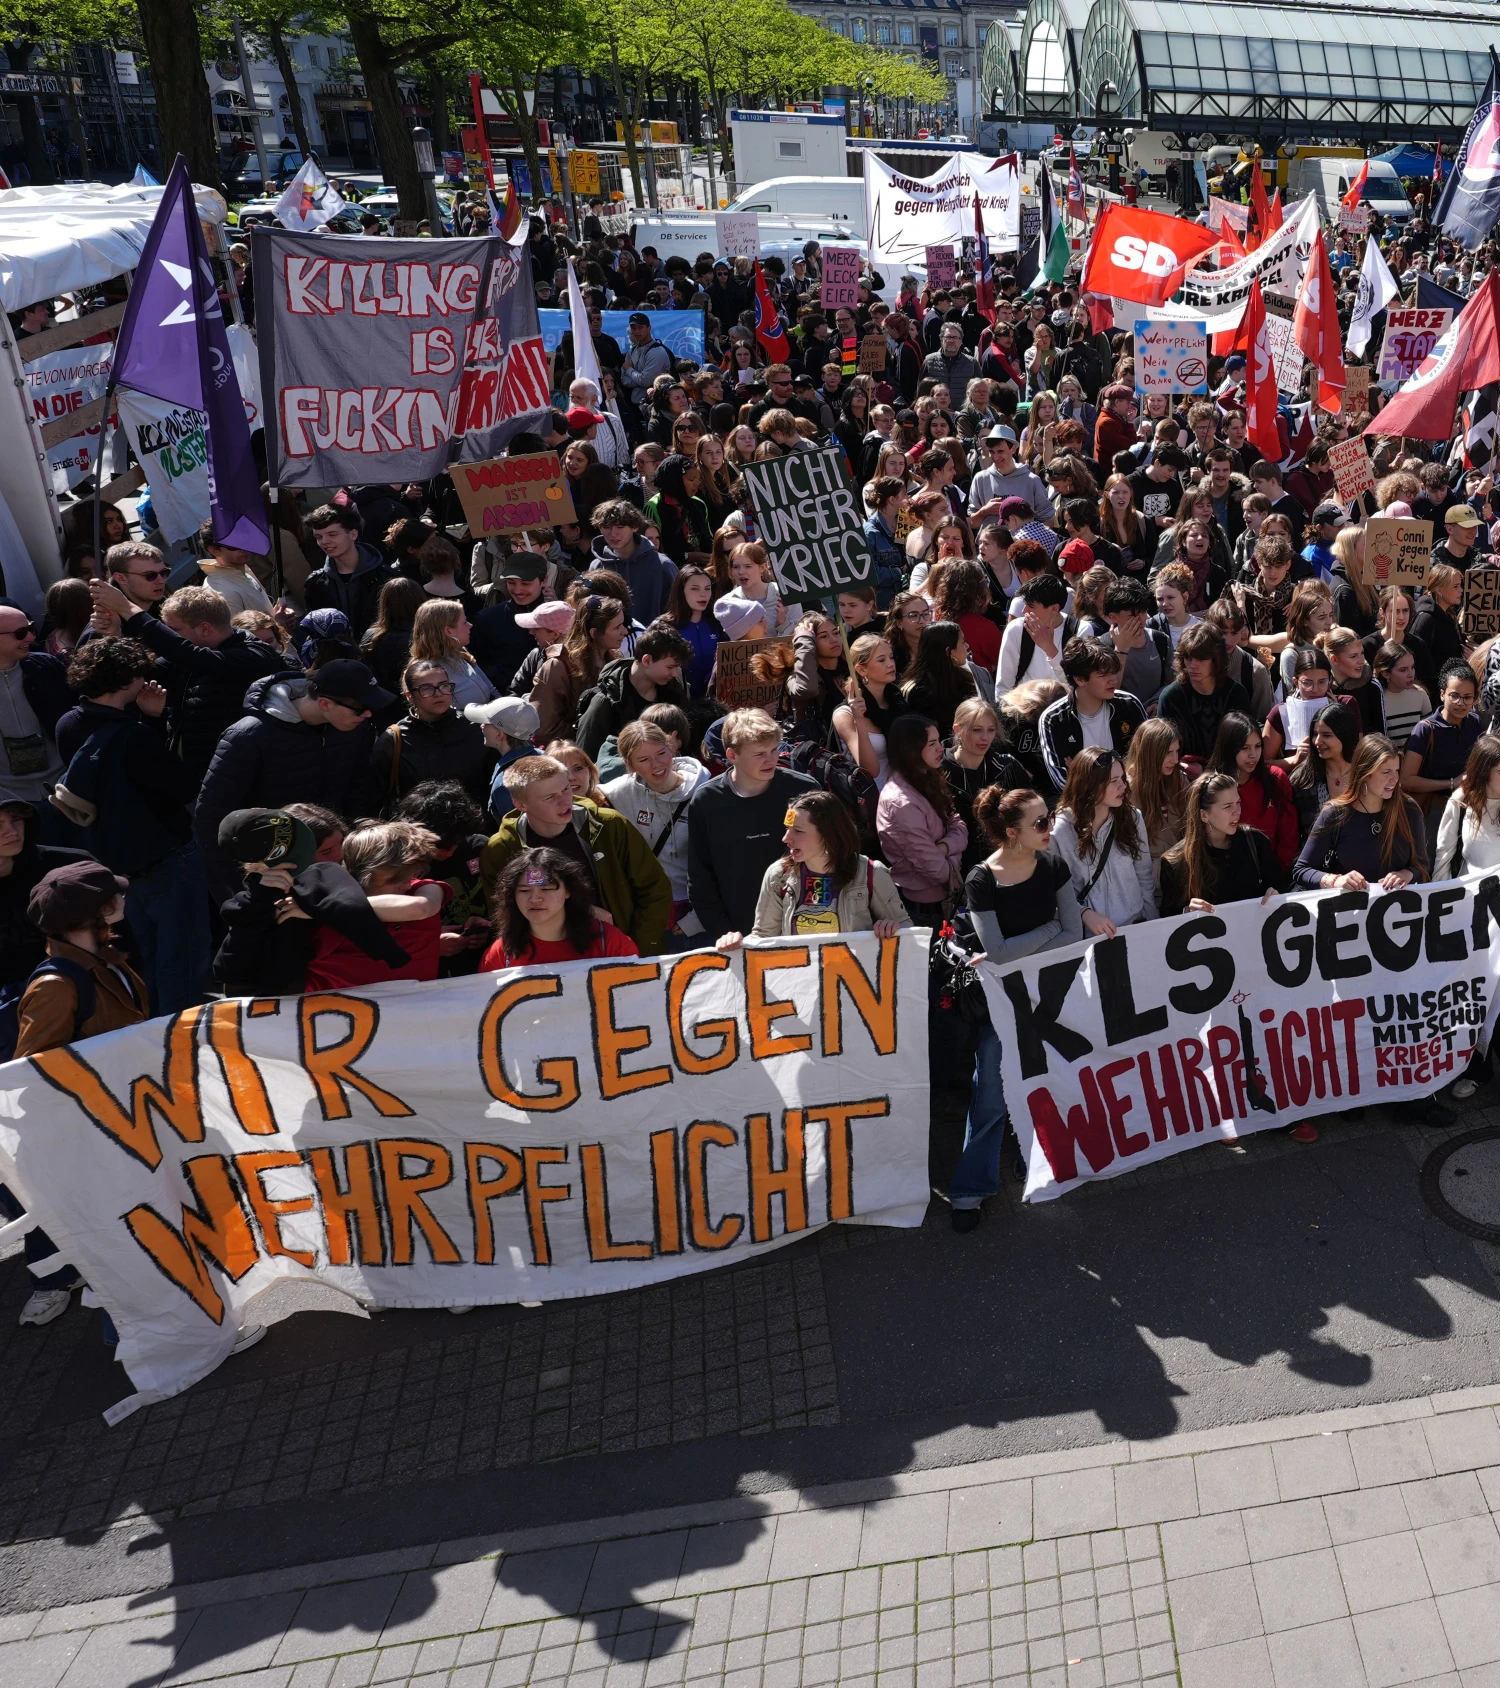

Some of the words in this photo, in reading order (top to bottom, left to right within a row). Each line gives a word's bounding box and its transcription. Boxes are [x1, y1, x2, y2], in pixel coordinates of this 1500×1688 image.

[894, 200, 934, 216] gegen
[826, 252, 857, 266] MERZ
[284, 254, 482, 317] KILLING
[826, 270, 857, 284] LECK
[1186, 278, 1239, 293] EHEN
[826, 288, 855, 303] EIER
[1165, 289, 1211, 307] URE
[1264, 294, 1295, 317] Bildung
[1389, 310, 1446, 329] HERZ
[410, 326, 457, 376] IS
[1385, 334, 1441, 358] STAT
[44, 368, 66, 384] VON
[51, 391, 83, 417] DIE
[280, 386, 463, 458] FUCKIN
[1335, 447, 1359, 463] Krieg
[466, 456, 561, 491] MARSCH
[1354, 460, 1367, 474] auf
[744, 448, 844, 512] NICHT
[1339, 478, 1375, 501] Rücken
[505, 487, 527, 501] IST
[483, 501, 550, 532] ARSCH
[758, 489, 861, 547] UNSER
[1396, 527, 1425, 543] Conni
[769, 530, 871, 595] KRIEG
[1399, 544, 1429, 558] gegen
[1397, 558, 1425, 579] Krieg
[1464, 613, 1496, 633] DER
[721, 662, 753, 677] NICH
[1001, 915, 1236, 1081] KLS
[1365, 976, 1487, 1023] UNSERE
[27, 995, 416, 1171] WIR
[478, 936, 900, 1113] GEGEN
[1375, 1036, 1460, 1068] KRIEGT
[1376, 1047, 1475, 1087] NICHT
[121, 1096, 891, 1326] WEHRPFLICHT
